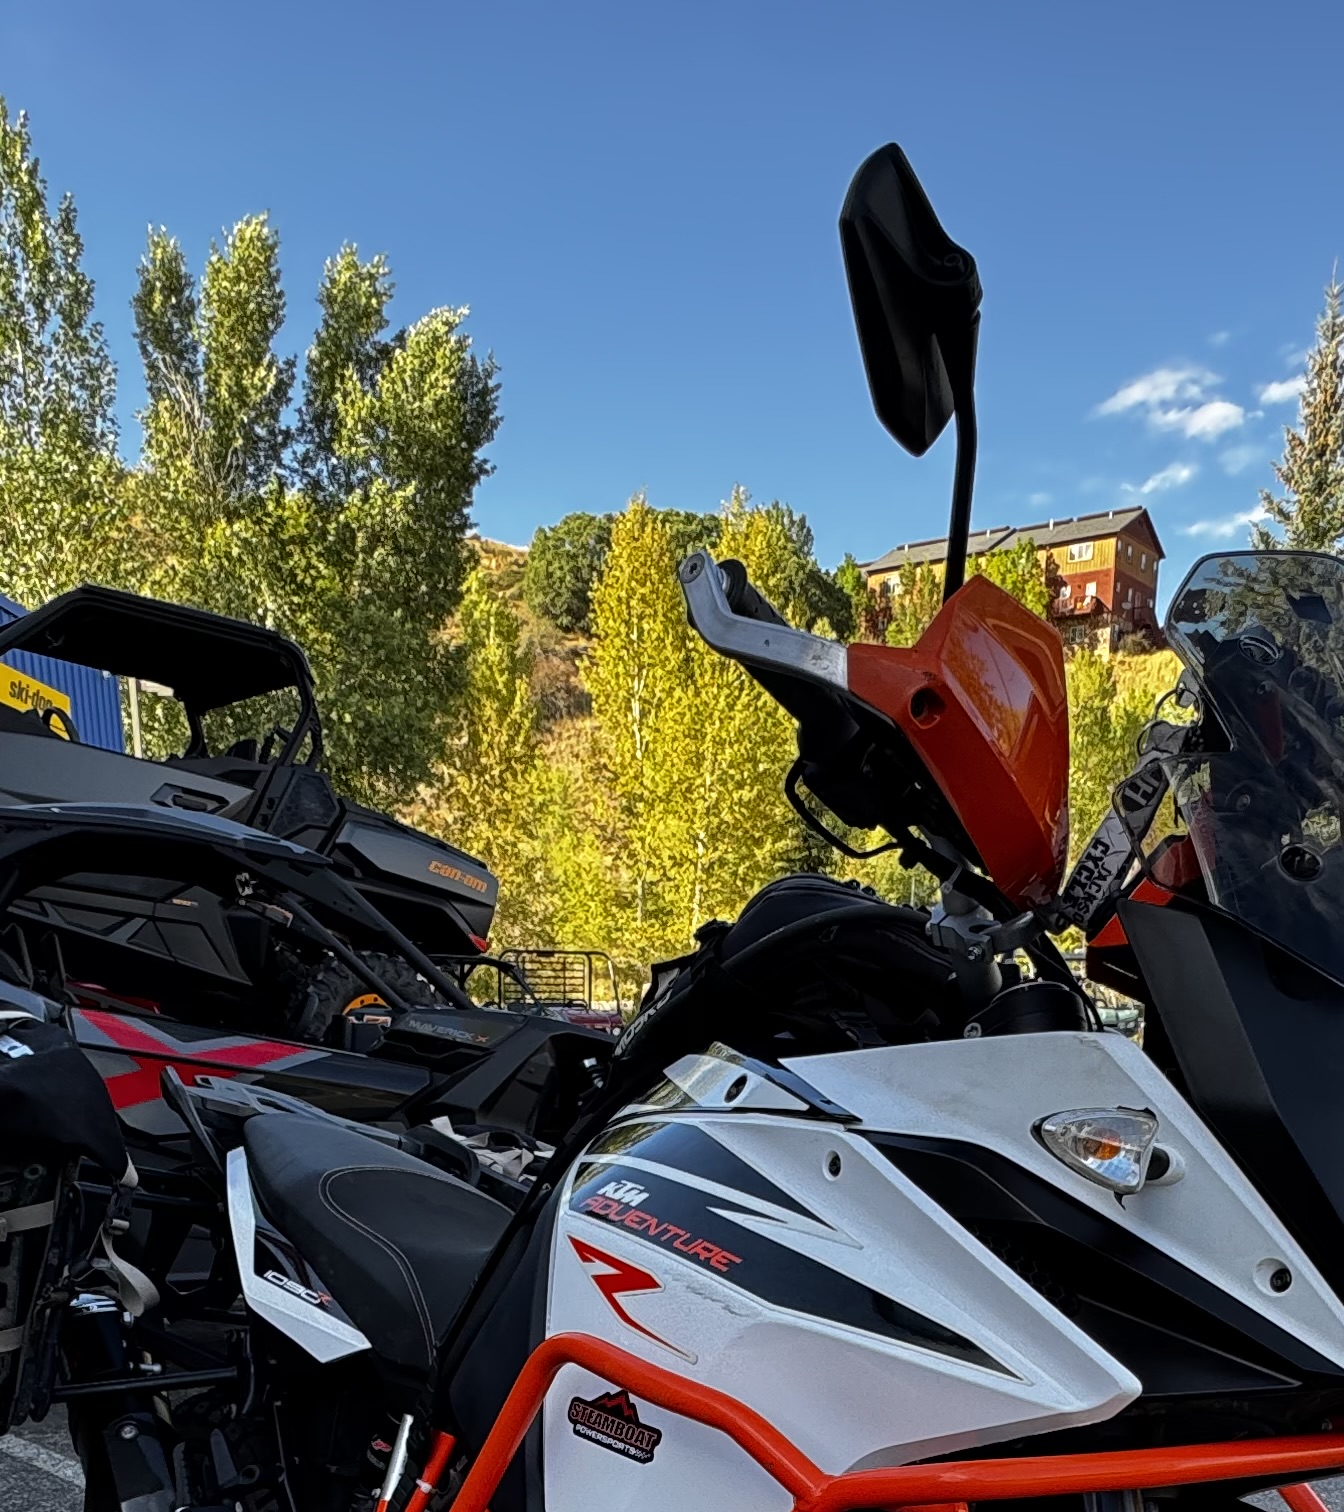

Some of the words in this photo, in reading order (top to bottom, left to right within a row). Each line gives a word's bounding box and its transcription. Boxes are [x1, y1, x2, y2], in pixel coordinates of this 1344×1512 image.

[1072, 863, 1113, 924] JACKSO
[408, 1020, 475, 1042] MAVERICK
[597, 1179, 650, 1207] KTM
[578, 1196, 744, 1273] ADVENTURE
[570, 1401, 657, 1451] STEAMBOAT
